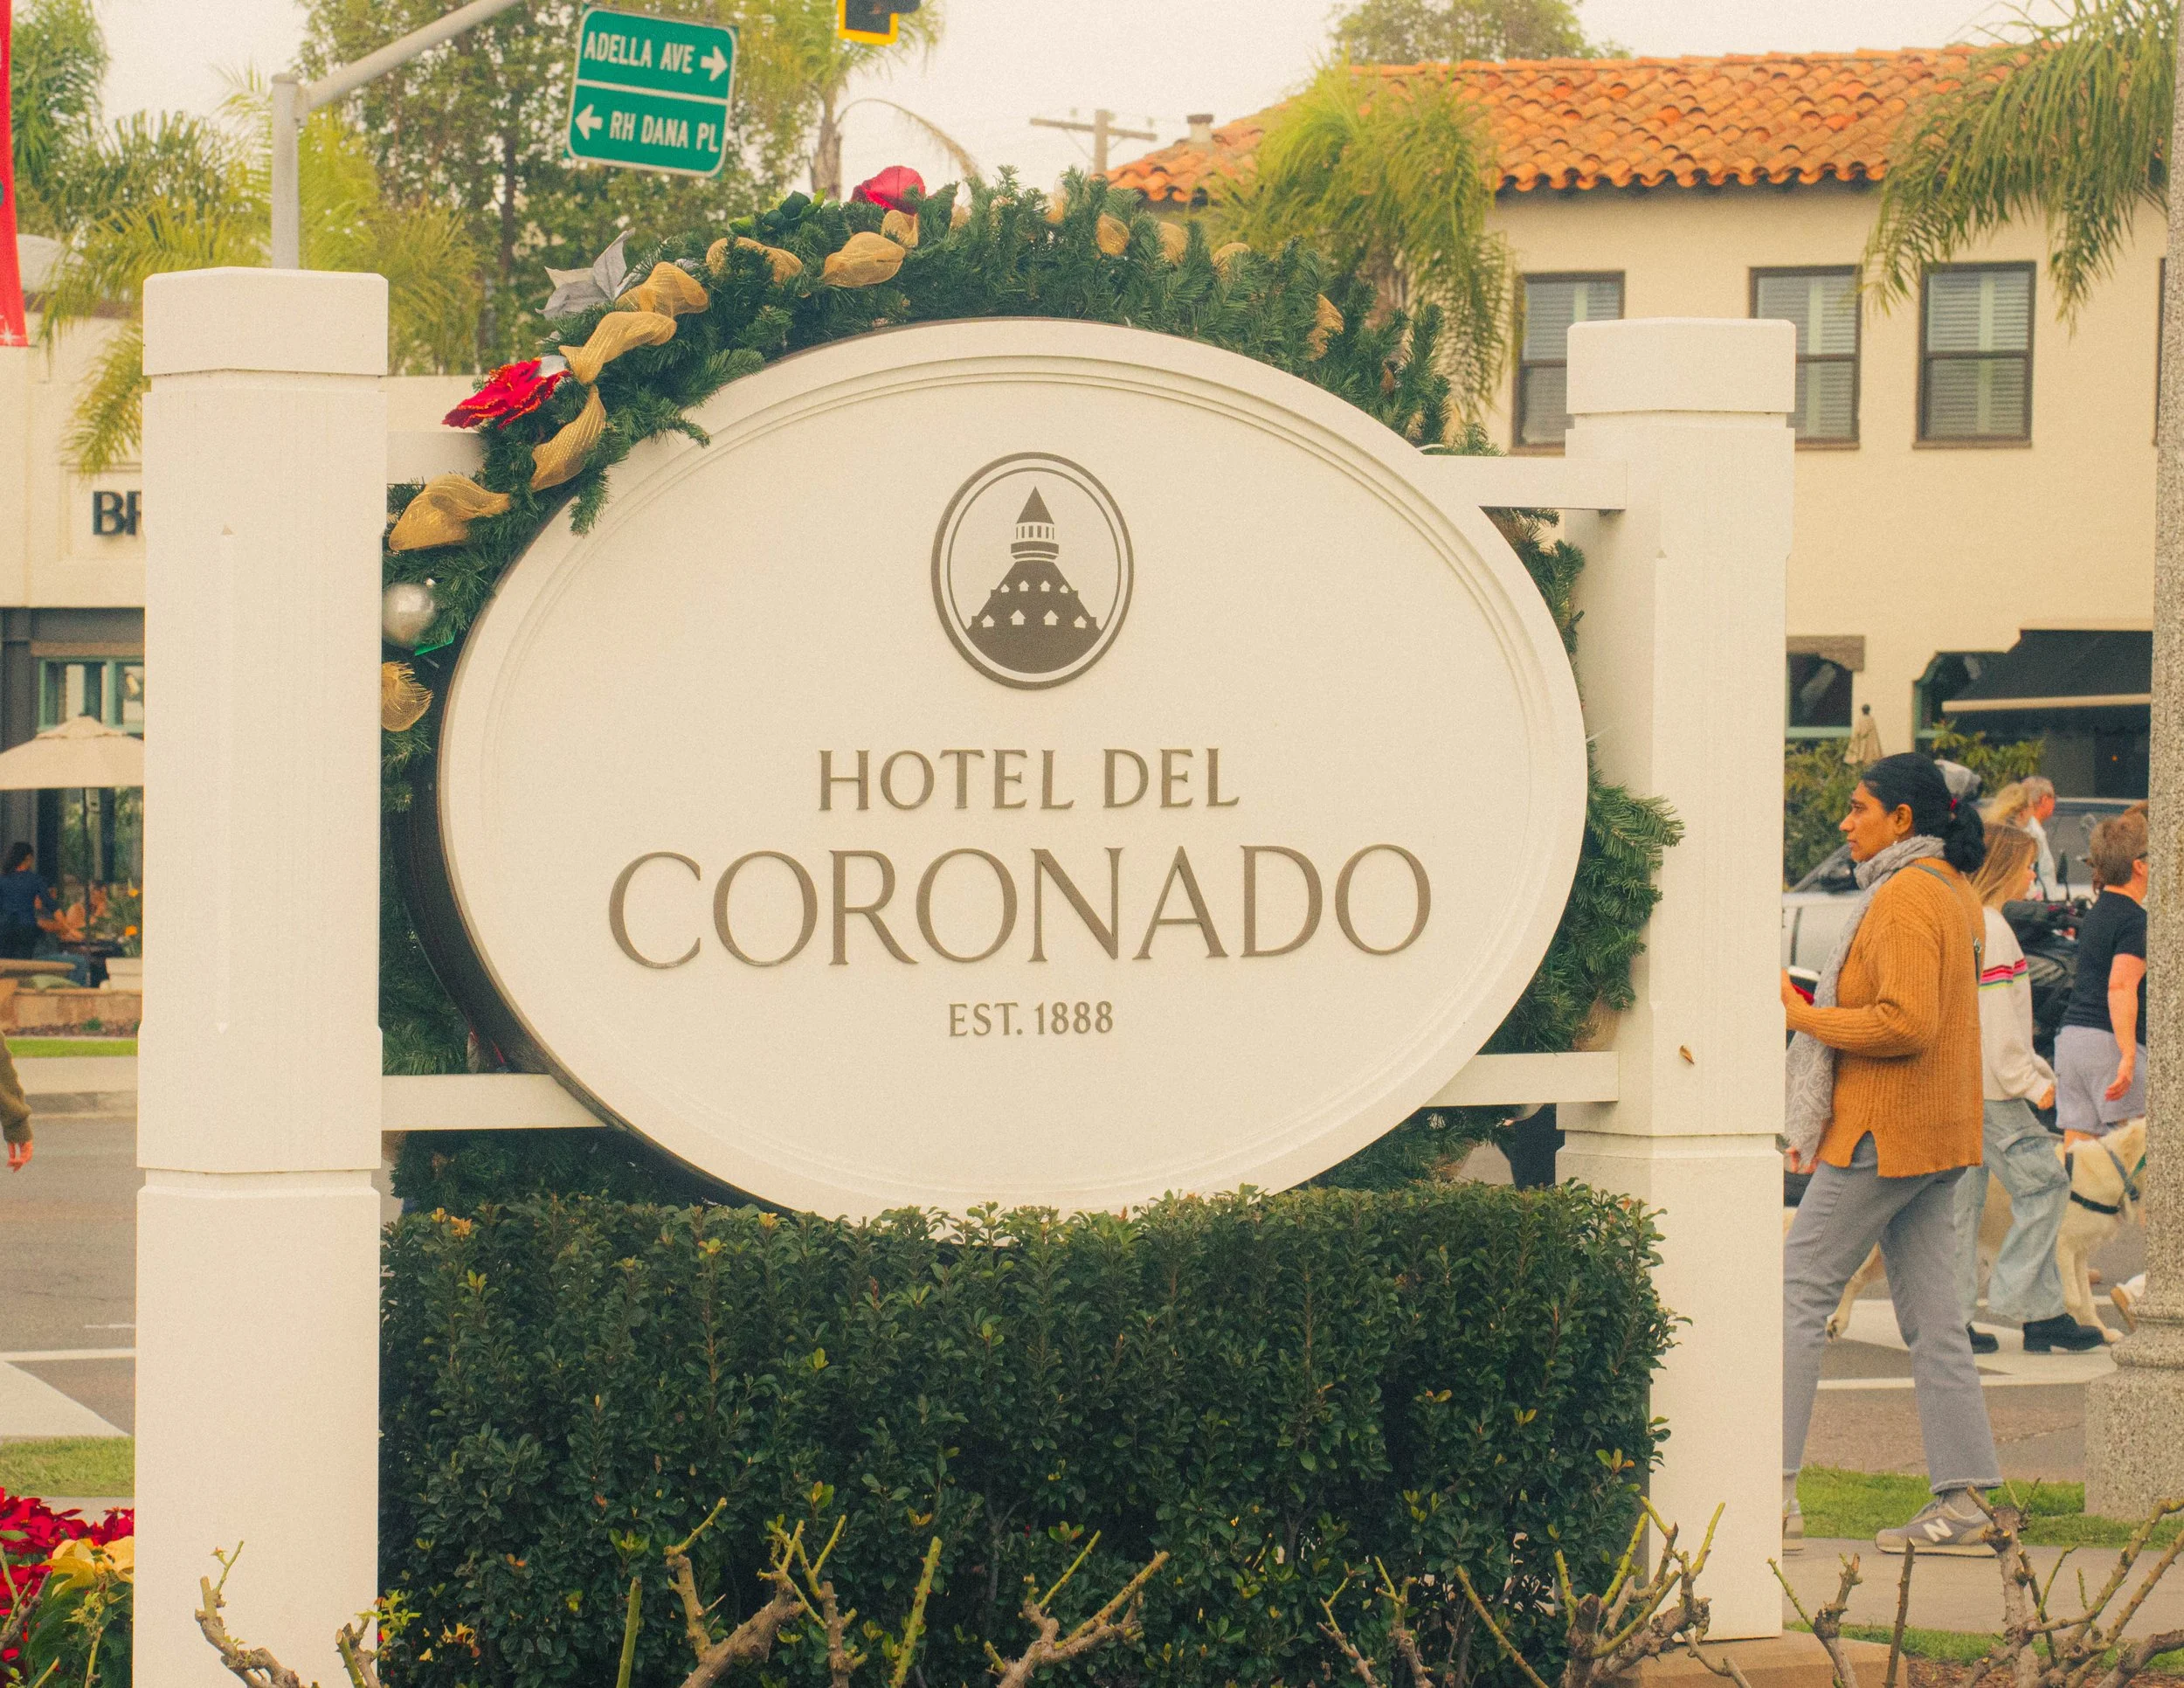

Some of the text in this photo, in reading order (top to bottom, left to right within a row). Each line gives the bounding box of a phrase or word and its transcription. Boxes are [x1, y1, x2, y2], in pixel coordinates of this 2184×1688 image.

[584, 31, 695, 74] ADELLA AVE
[609, 110, 719, 153] RH DANA PL
[818, 747, 1241, 812] HOTEL DEL
[609, 844, 1431, 970] CORONADO
[950, 1000, 1114, 1037] EST. 1888
